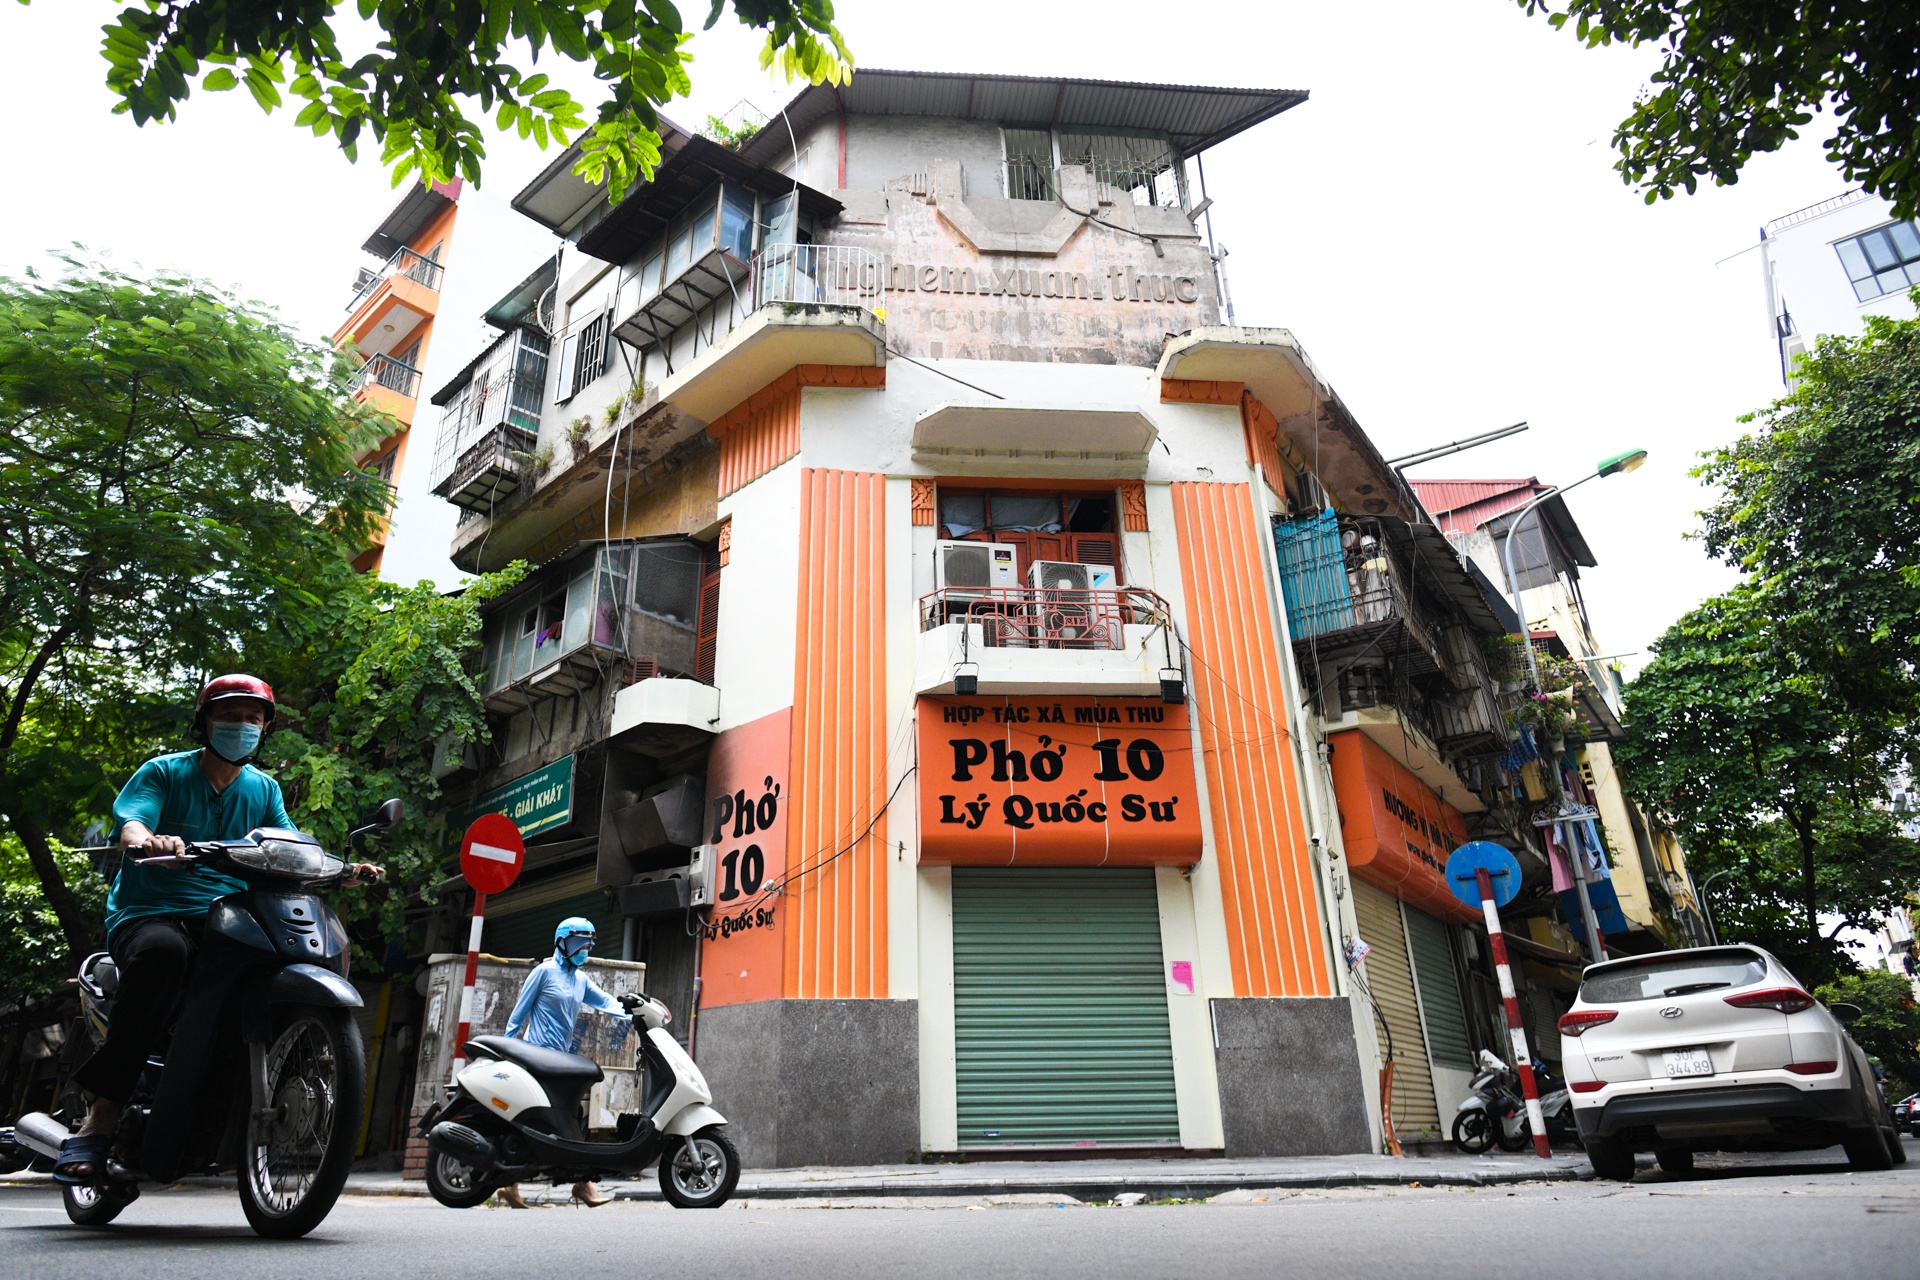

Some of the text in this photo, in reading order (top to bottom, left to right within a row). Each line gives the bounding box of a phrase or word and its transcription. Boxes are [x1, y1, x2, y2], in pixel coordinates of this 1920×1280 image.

[943, 703, 1164, 726] HỢP TÁC XÃ MÙA THU
[948, 735, 1165, 782] Phở 10
[515, 792, 534, 818] GIẢI
[536, 782, 563, 810] KHÁT
[939, 789, 1178, 829] Lý Quốc Sư
[711, 775, 780, 902] Phở 10
[721, 908, 753, 938] Quốc
[756, 907, 775, 927] Sư
[1666, 1060, 1710, 1076] 344.89
[1672, 1047, 1697, 1062] 30F
